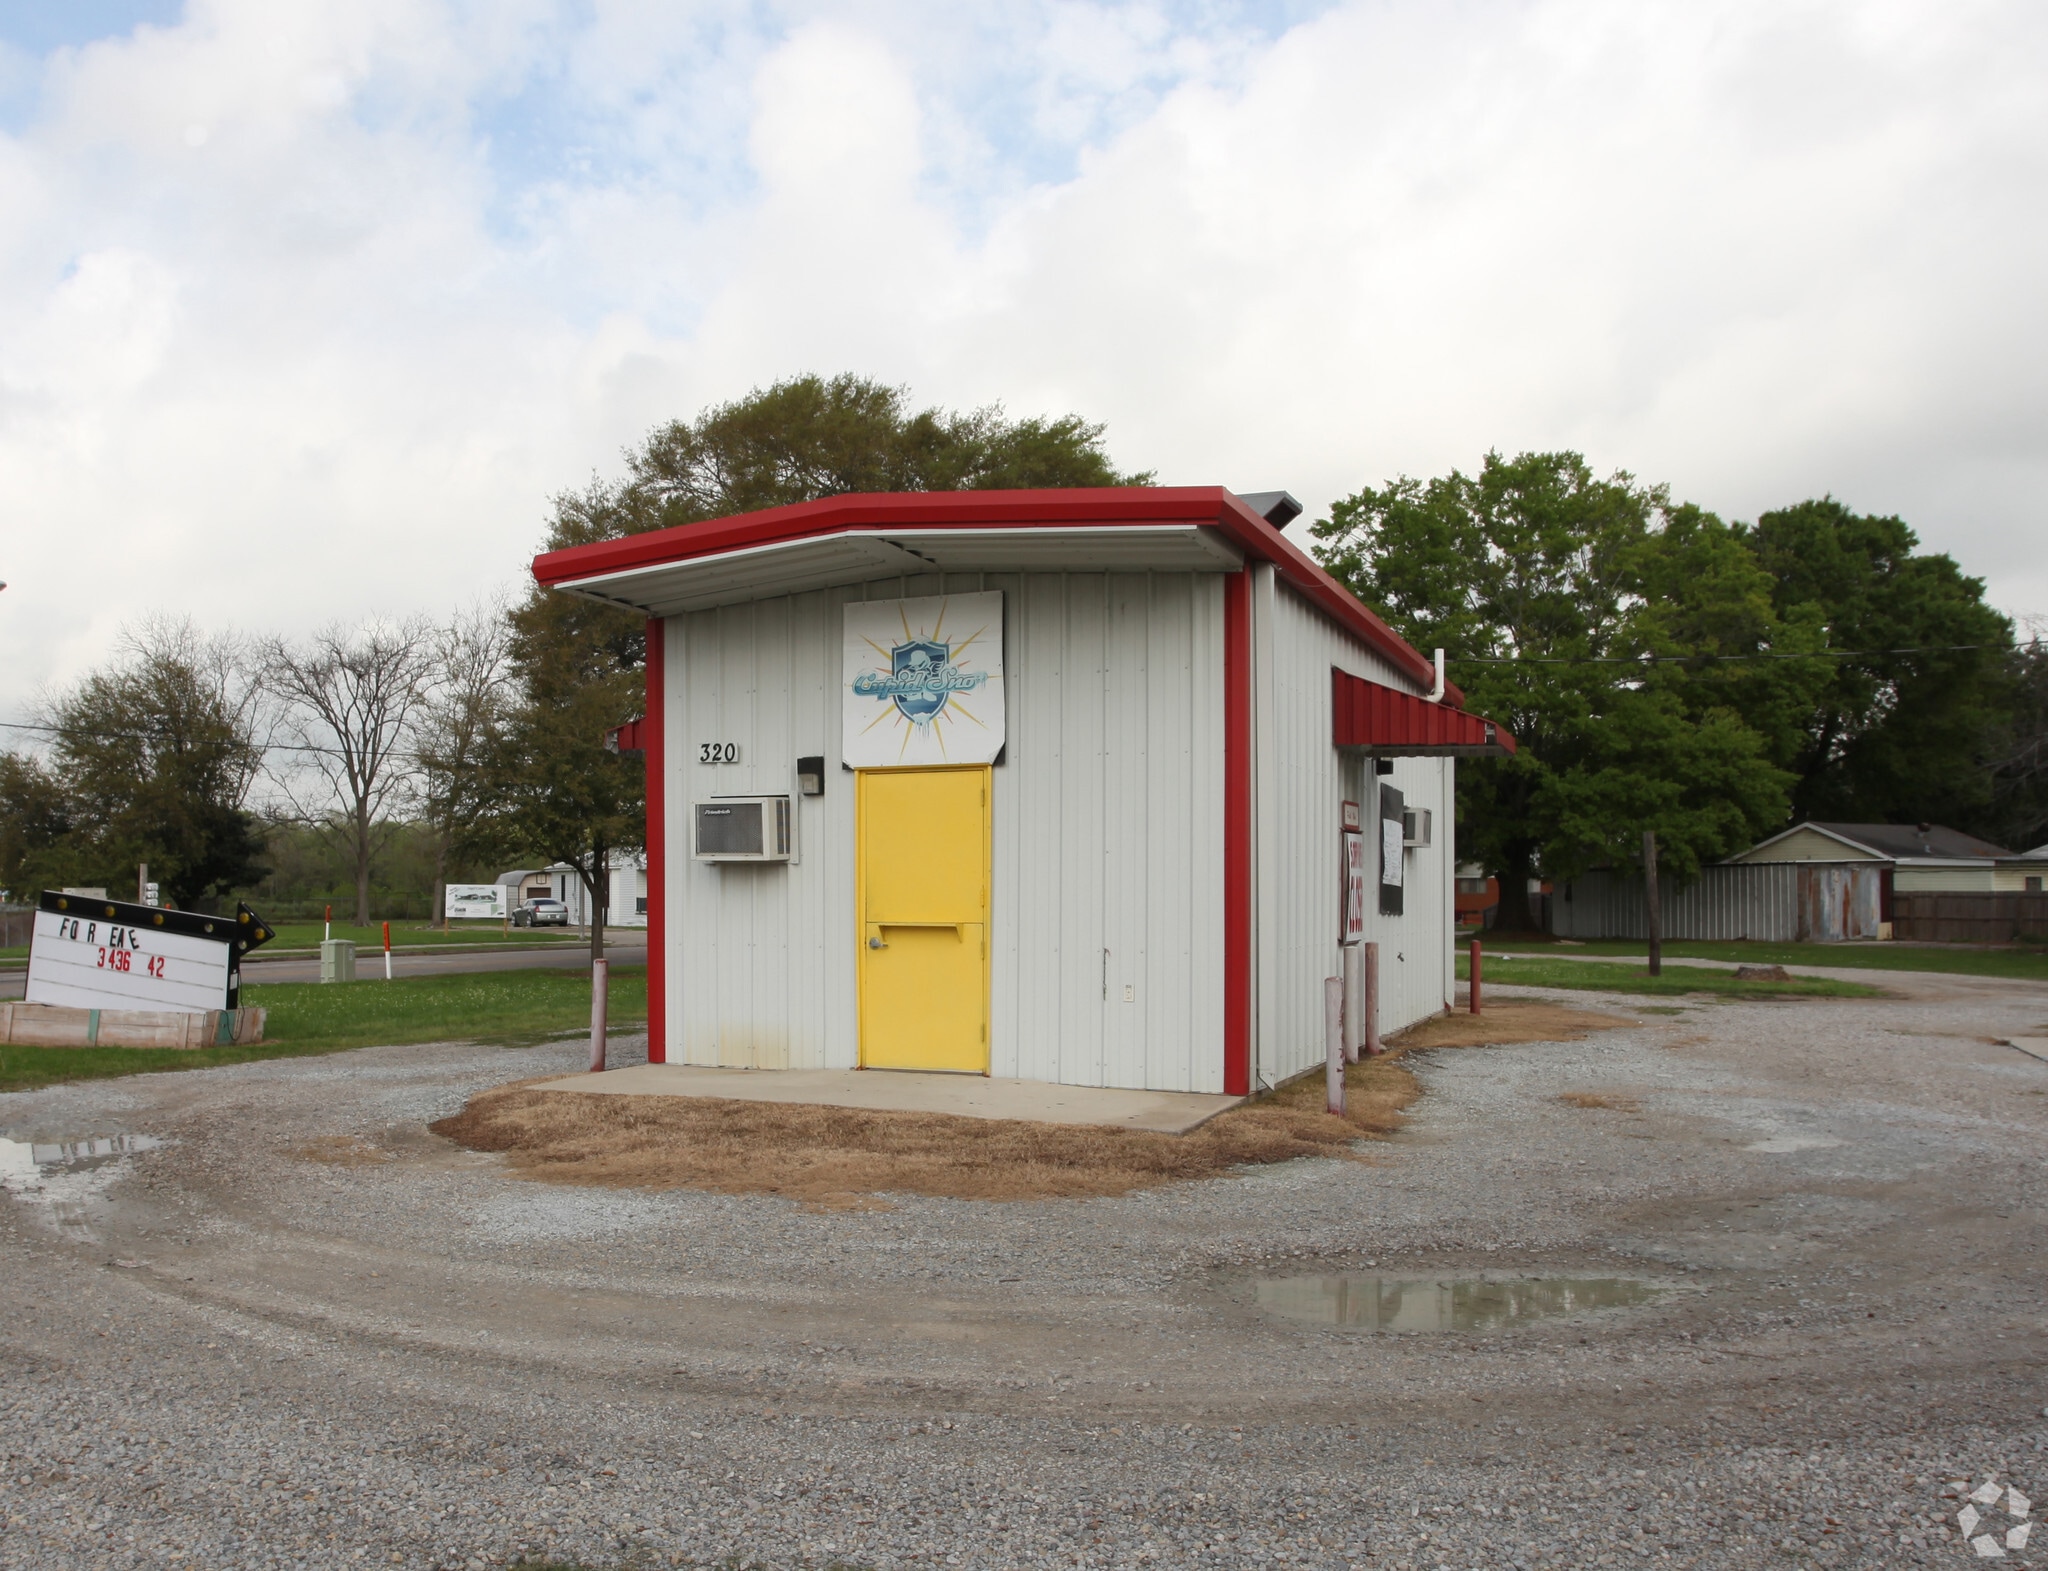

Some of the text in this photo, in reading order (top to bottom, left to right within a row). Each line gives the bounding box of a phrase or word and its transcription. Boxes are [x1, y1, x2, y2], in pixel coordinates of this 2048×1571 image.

[852, 671, 923, 700] Cupid
[700, 743, 736, 762] 320
[147, 955, 165, 978] 42
